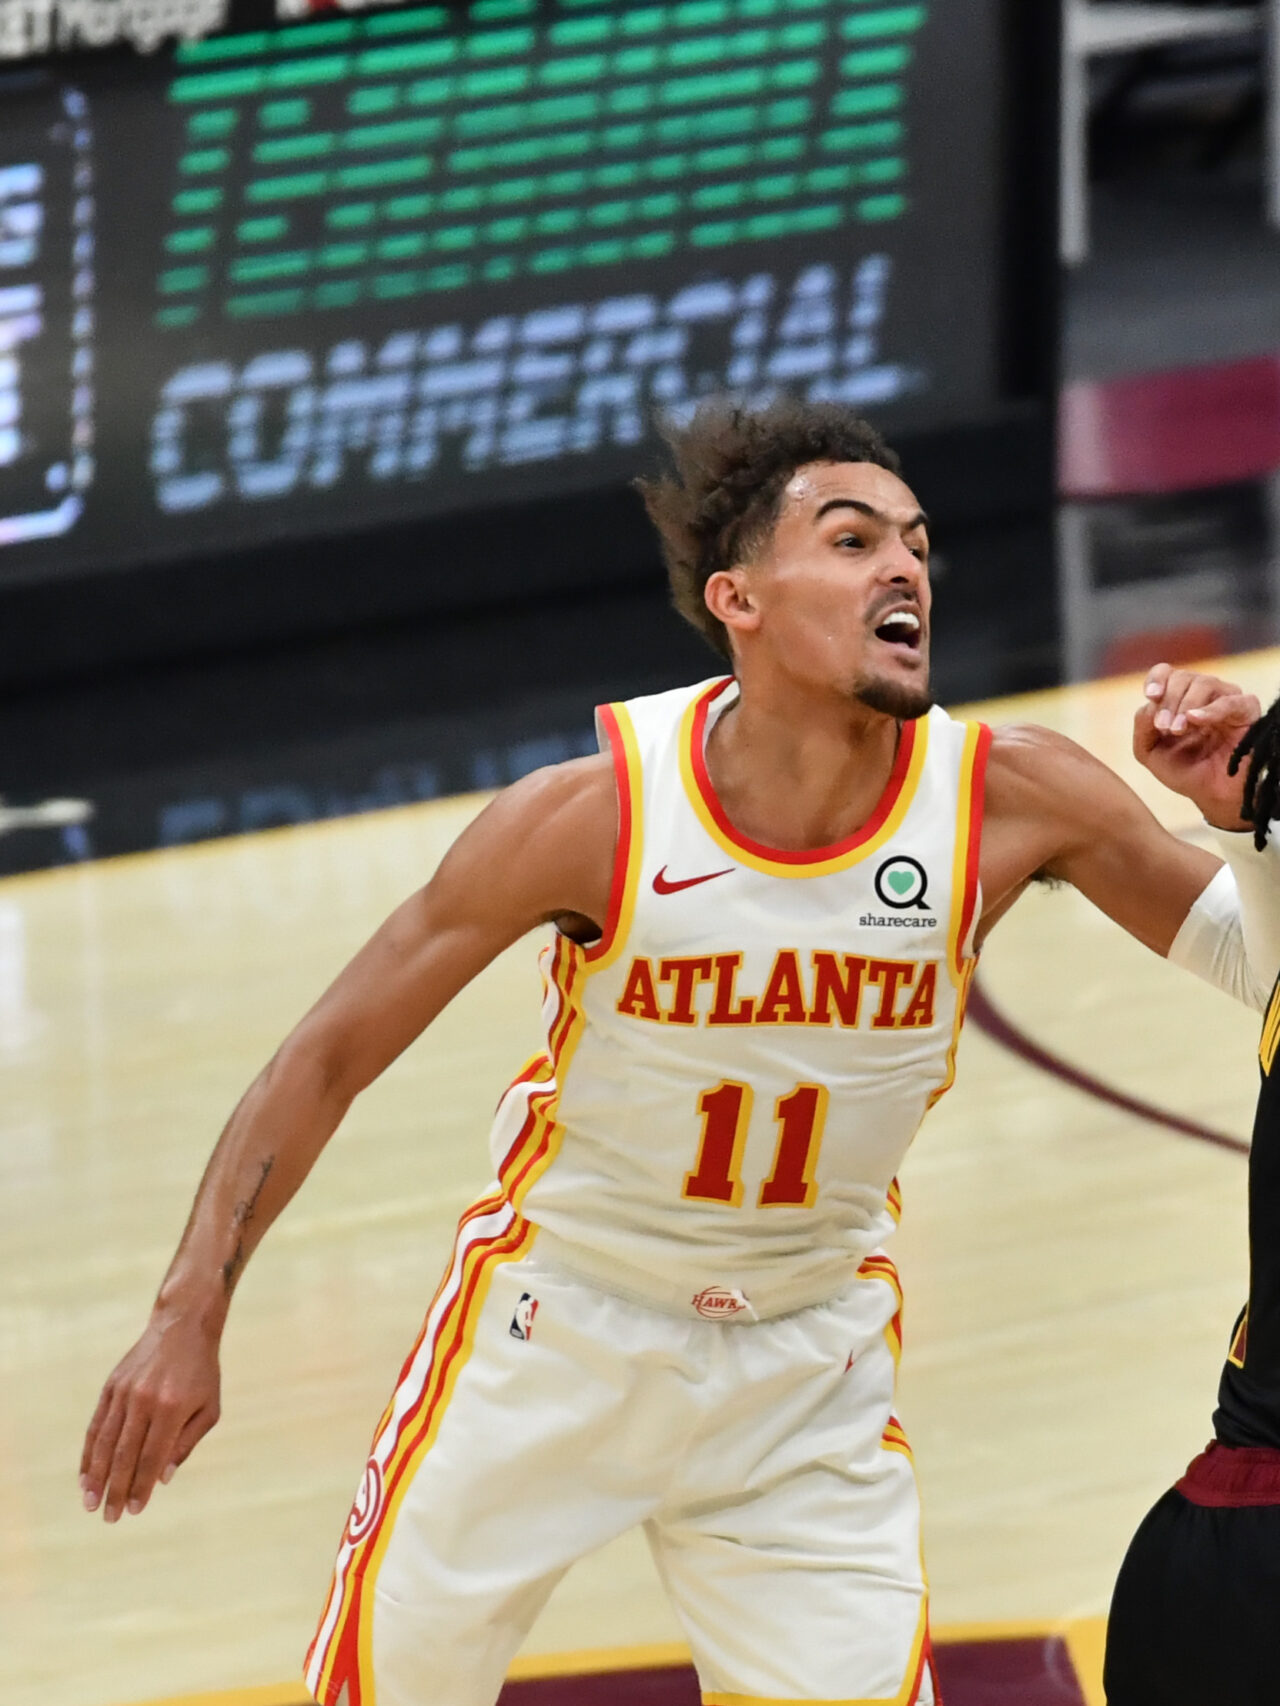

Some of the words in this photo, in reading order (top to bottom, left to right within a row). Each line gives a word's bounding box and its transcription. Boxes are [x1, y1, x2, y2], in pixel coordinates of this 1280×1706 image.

[152, 253, 916, 512] COMMERCIAL
[858, 913, 937, 928] sharecare
[617, 948, 938, 1030] ATLANTA
[681, 1078, 830, 1210] 11
[690, 1293, 747, 1310] HAWK
